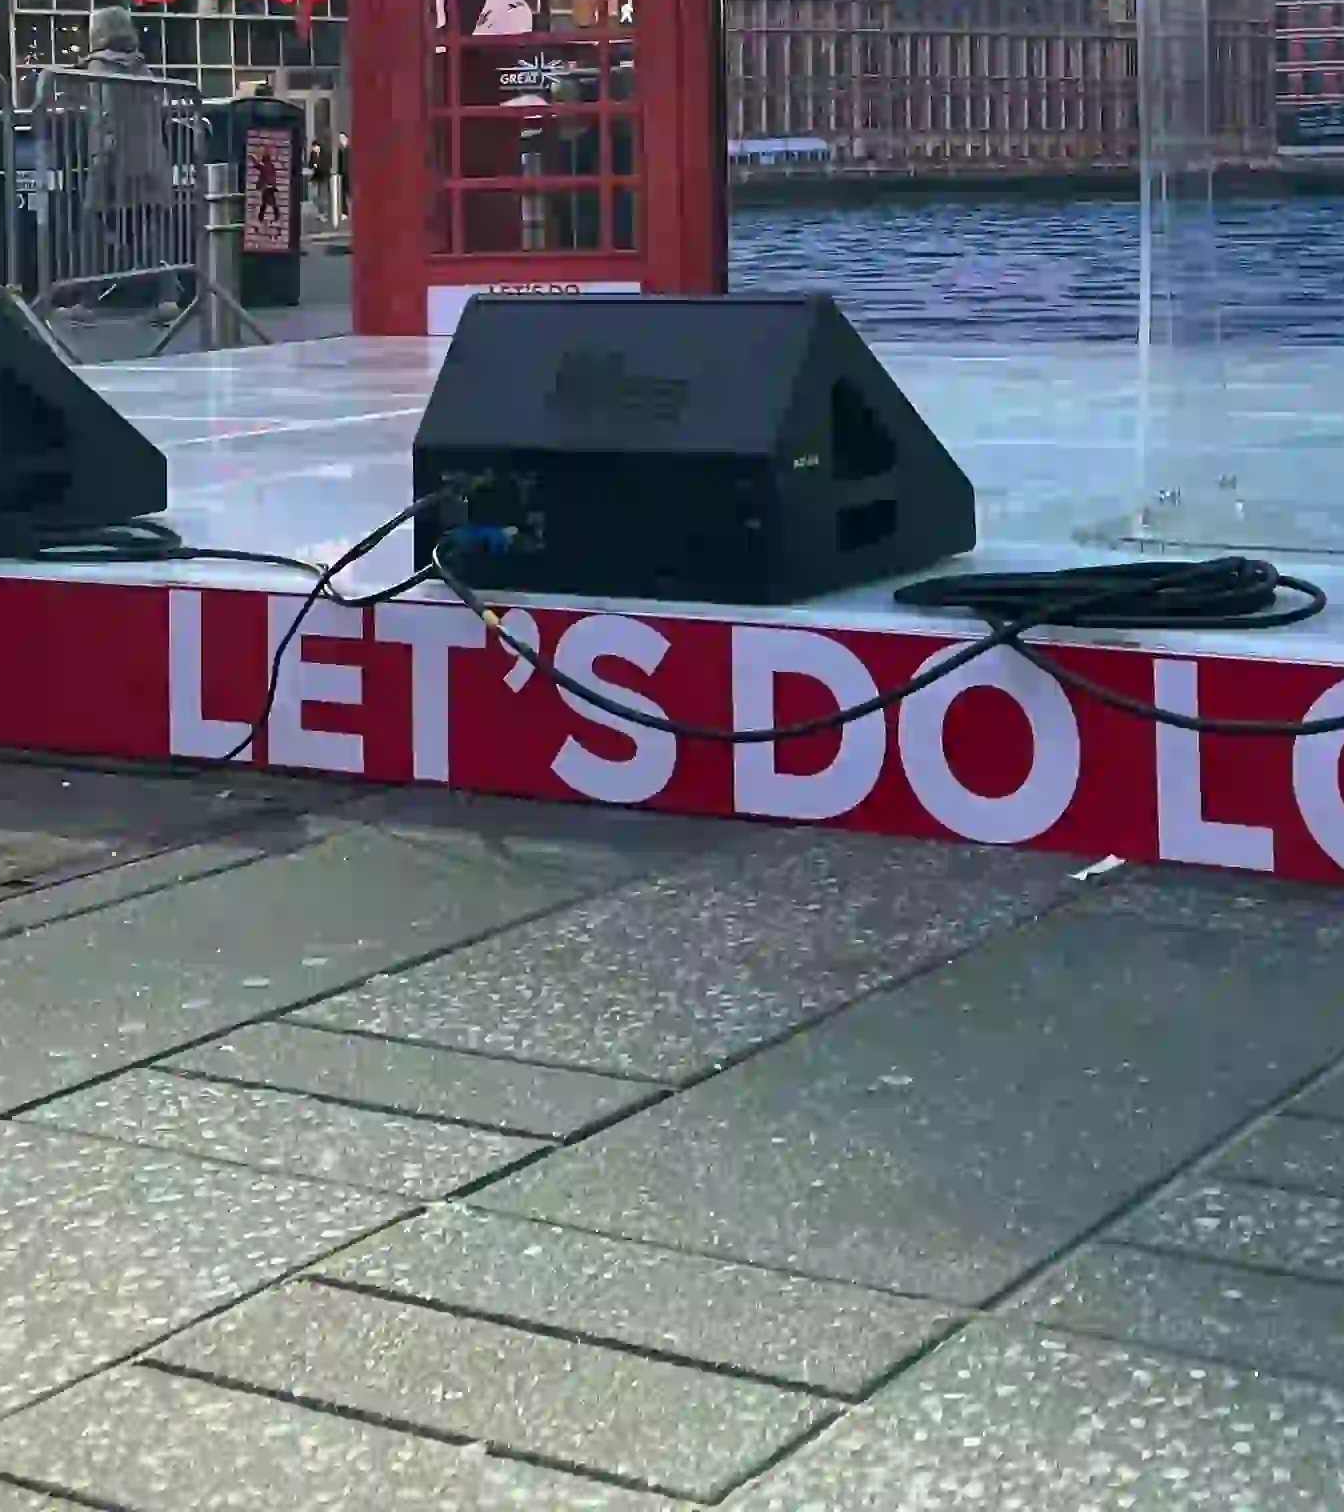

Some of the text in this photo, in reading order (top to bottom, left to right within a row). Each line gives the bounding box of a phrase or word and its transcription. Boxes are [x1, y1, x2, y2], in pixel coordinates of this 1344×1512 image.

[500, 71, 540, 86] GREAT
[168, 588, 675, 805] LET'S
[731, 623, 1080, 844] DO
